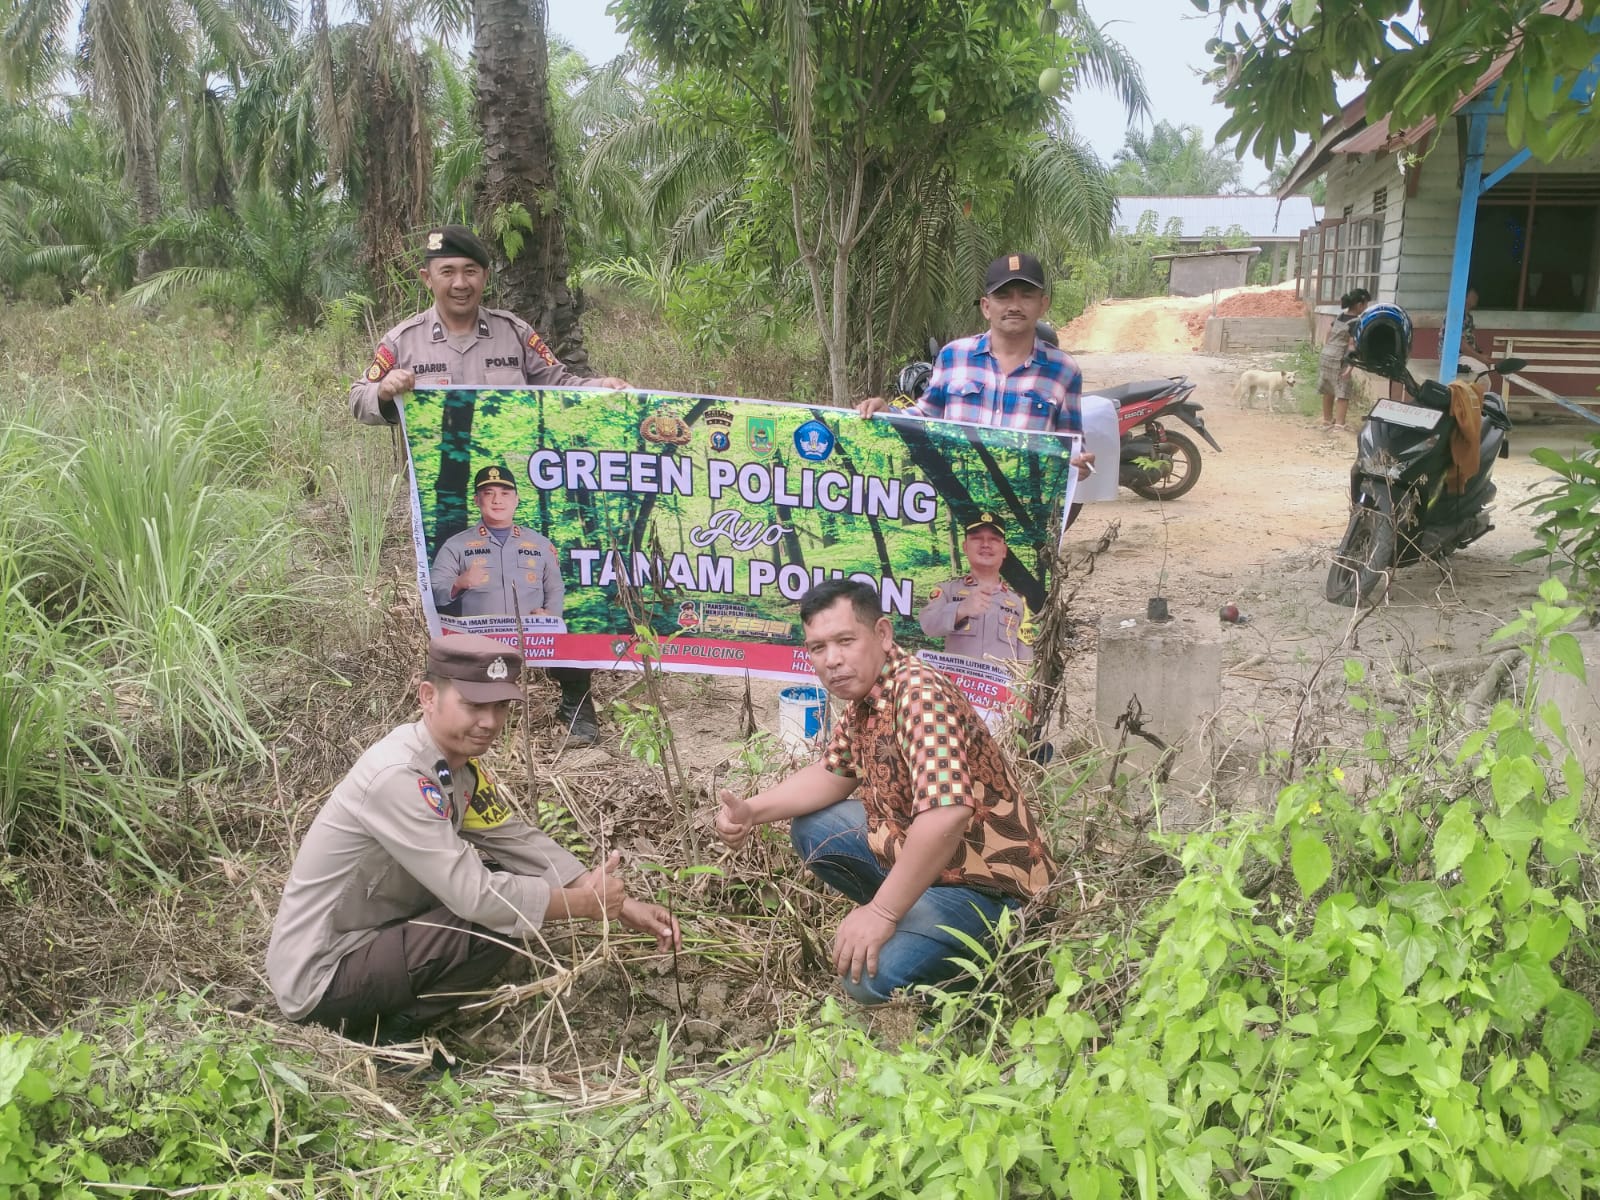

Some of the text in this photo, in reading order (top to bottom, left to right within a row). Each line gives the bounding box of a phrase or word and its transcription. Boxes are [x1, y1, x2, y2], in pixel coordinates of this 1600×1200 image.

[485, 356, 519, 368] POLRI
[527, 449, 938, 523] GREEN POLICING
[690, 509, 793, 552] Ayo
[571, 549, 913, 616] TANAM PON
[468, 618, 488, 626] IMAM
[525, 636, 554, 646] TUAH
[523, 648, 554, 658] RWAH
[682, 644, 745, 660] POLICING
[922, 652, 938, 661] IPDA
[939, 655, 965, 666] MARTIN
[965, 658, 991, 670] LUTHER
[955, 676, 999, 696] POLRES
